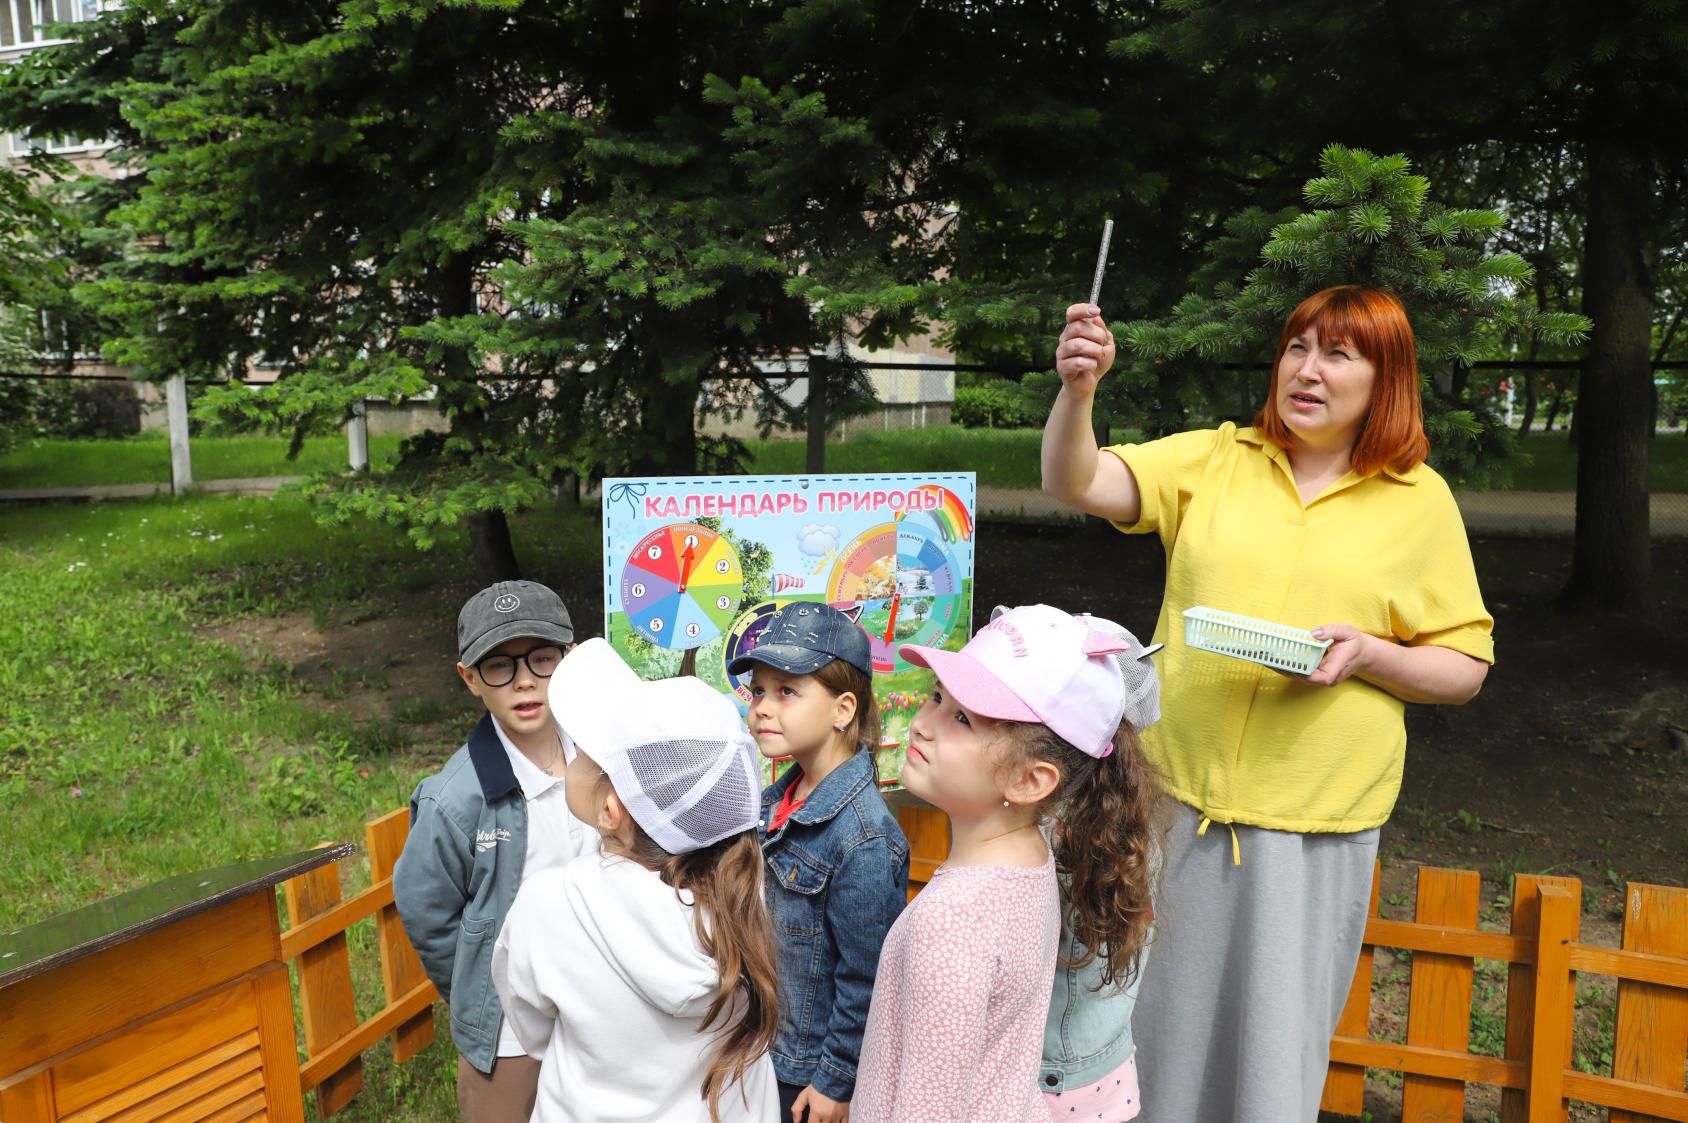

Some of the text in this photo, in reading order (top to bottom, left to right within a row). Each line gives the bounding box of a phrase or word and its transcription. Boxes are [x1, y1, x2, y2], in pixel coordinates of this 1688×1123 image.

[644, 488, 945, 519] КАЛЕНДАРЬ ПРИРОДЫ
[899, 532, 925, 544] ДЕКАБРЬ
[651, 547, 658, 557] 7
[840, 540, 863, 563] ОСЕНЬ
[719, 562, 726, 572] 2
[635, 585, 642, 595] 6
[720, 597, 727, 608] 3
[653, 619, 660, 630] 5
[689, 625, 696, 635] 4
[736, 686, 753, 702] ВЕЧ
